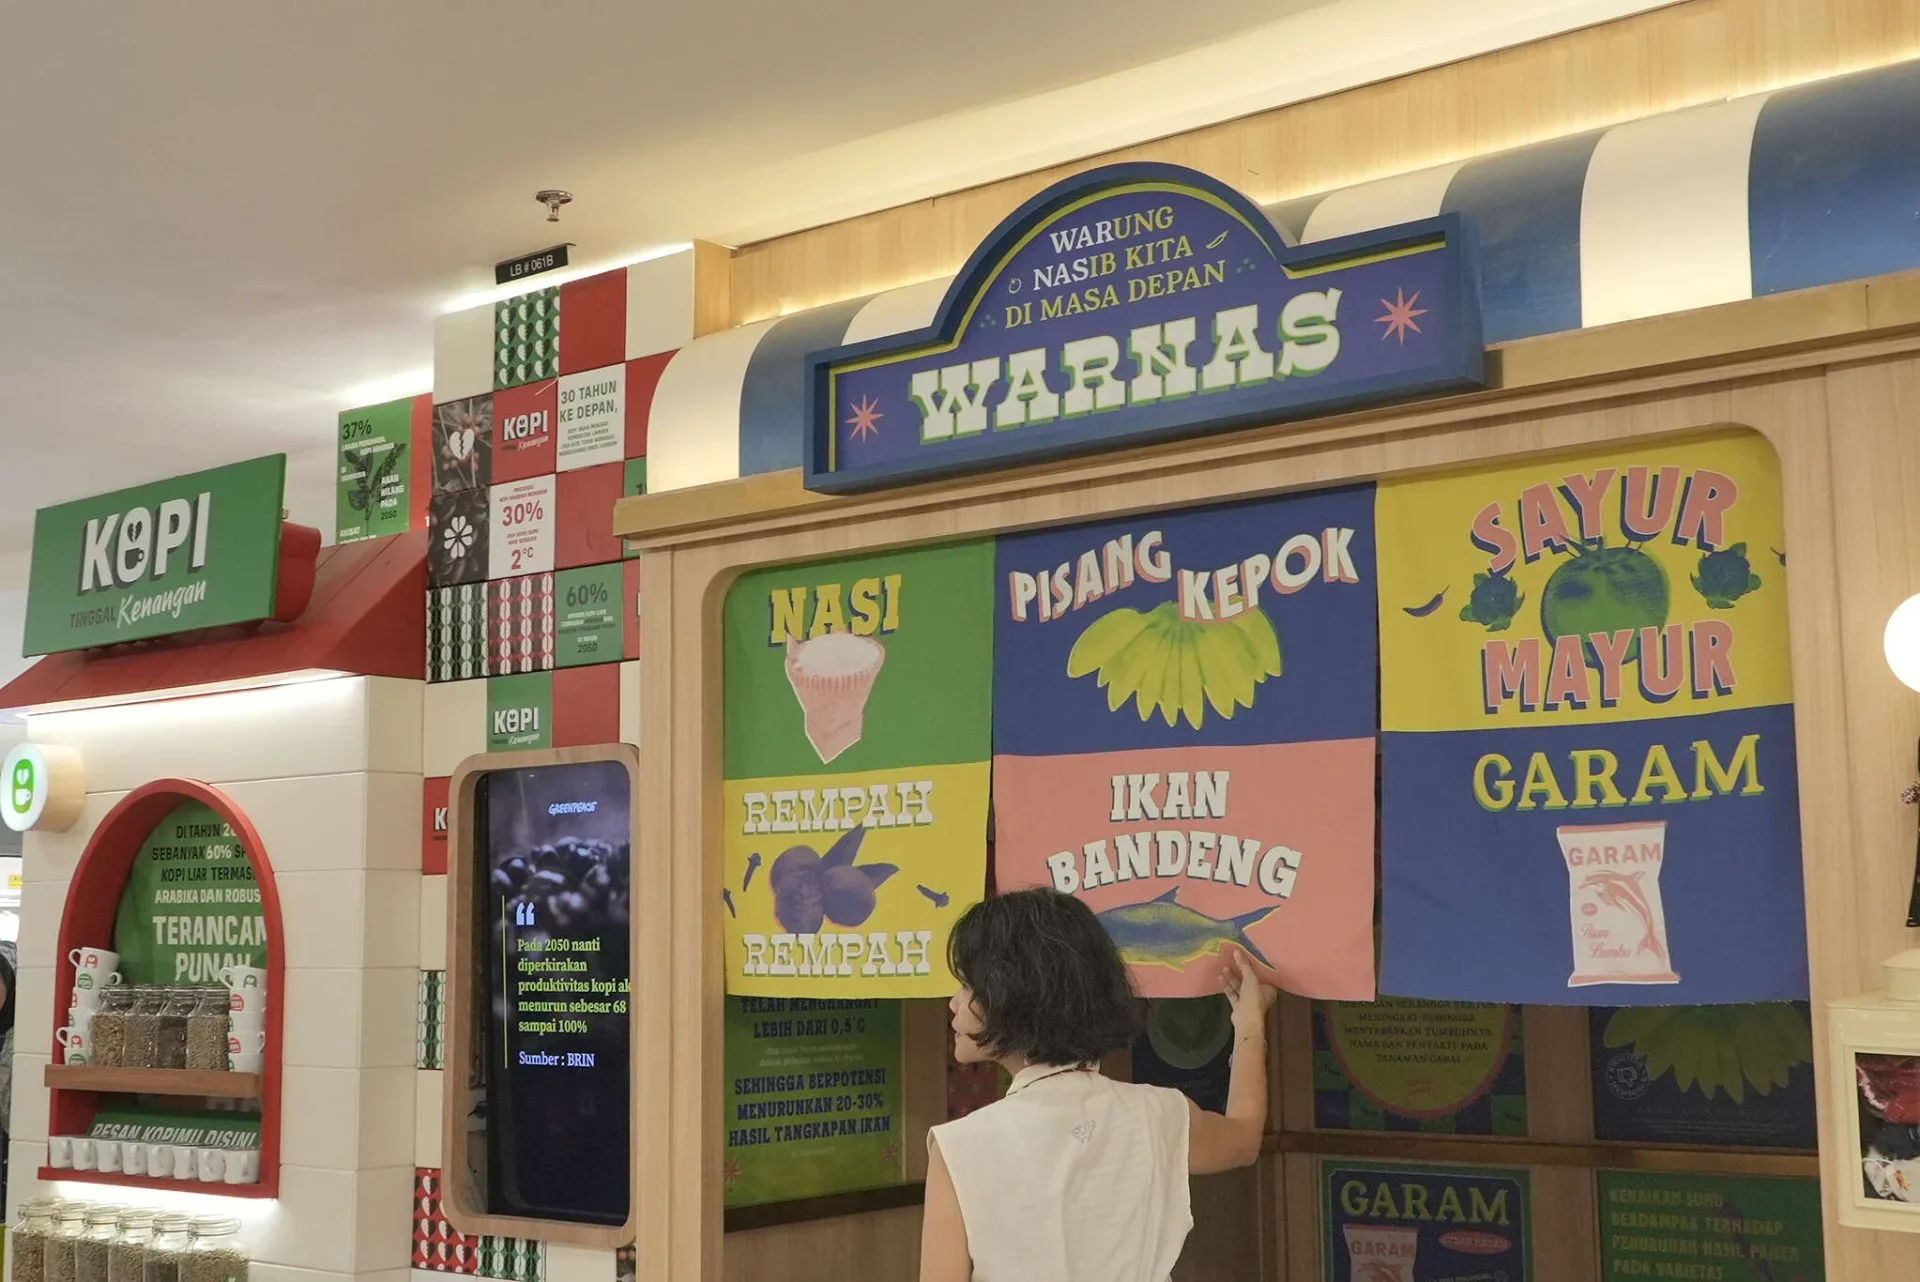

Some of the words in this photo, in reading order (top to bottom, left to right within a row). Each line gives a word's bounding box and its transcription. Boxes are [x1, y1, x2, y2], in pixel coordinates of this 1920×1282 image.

[1050, 206, 1175, 253] WARUNG
[510, 264, 522, 276] LB
[531, 255, 554, 270] 061B
[1033, 252, 1117, 291] NASIB
[1125, 235, 1194, 270] KITA
[1005, 303, 1031, 329] DI
[1040, 285, 1120, 321] MASA
[1128, 260, 1226, 303] DEPAN
[908, 286, 1343, 444] WARNAS
[560, 390, 575, 405] 30
[578, 380, 617, 400] TAHUN
[503, 410, 548, 441] KOPI
[559, 408, 574, 423] KE
[342, 419, 372, 440] 37%
[502, 500, 543, 527] 30%
[1470, 465, 1739, 578] SAYUR
[78, 491, 211, 597] KOPI
[1009, 530, 1172, 623] PISANG
[1178, 527, 1360, 623] KEPOK
[69, 606, 117, 629] TINGGAL
[116, 580, 207, 629] Kenangan
[566, 583, 608, 607] 60%
[767, 574, 902, 648] NASI
[1482, 619, 1738, 714] MAYUR
[493, 706, 539, 735] KOPI
[1472, 734, 1765, 812] GARAM
[742, 780, 934, 834] REMPAH
[1110, 770, 1230, 822] IKAN
[176, 825, 187, 839] DI
[434, 807, 448, 831] K
[152, 846, 205, 861] SEBANYAK
[206, 845, 232, 859] 60%
[1047, 830, 1302, 900] BANDENG
[1568, 843, 1661, 867] GARAM
[161, 868, 185, 882] KOPI
[188, 867, 208, 881] LIAR
[211, 867, 256, 881] TERMAS
[155, 889, 199, 904] ARABIKA
[200, 889, 223, 903] DAN
[517, 938, 543, 951] Pada
[544, 938, 570, 951] 2050
[571, 937, 601, 951] nanti
[742, 930, 932, 978] REMPAH
[517, 958, 587, 975] diperkirakan
[518, 979, 590, 995] produktivitas
[591, 978, 617, 994] kopi
[518, 1001, 567, 1013] menurun
[569, 1000, 611, 1013] sebesar
[613, 1000, 627, 1013] 68
[741, 998, 786, 1014] TELAH
[518, 1020, 557, 1036] sampai
[558, 1020, 588, 1033] 100%
[753, 1019, 793, 1039] LEBIH
[797, 1019, 827, 1037] DARI
[519, 1051, 559, 1065] Sumber
[567, 1053, 595, 1066] BRIN
[735, 1075, 804, 1095] SEHINGGA
[809, 1068, 886, 1090] BERPOTENSI
[737, 1097, 833, 1121] MENURUNKAN
[836, 1093, 884, 1111] 20-30%
[204, 1130, 257, 1148] DISINI
[729, 1129, 770, 1147] HASIL
[774, 1118, 857, 1142] TANGKAPAN
[861, 1115, 891, 1132] IKAN
[1340, 1180, 1511, 1226] GARAM
[1351, 1239, 1415, 1257] GARAM
[1613, 1258, 1651, 1276] PADA
